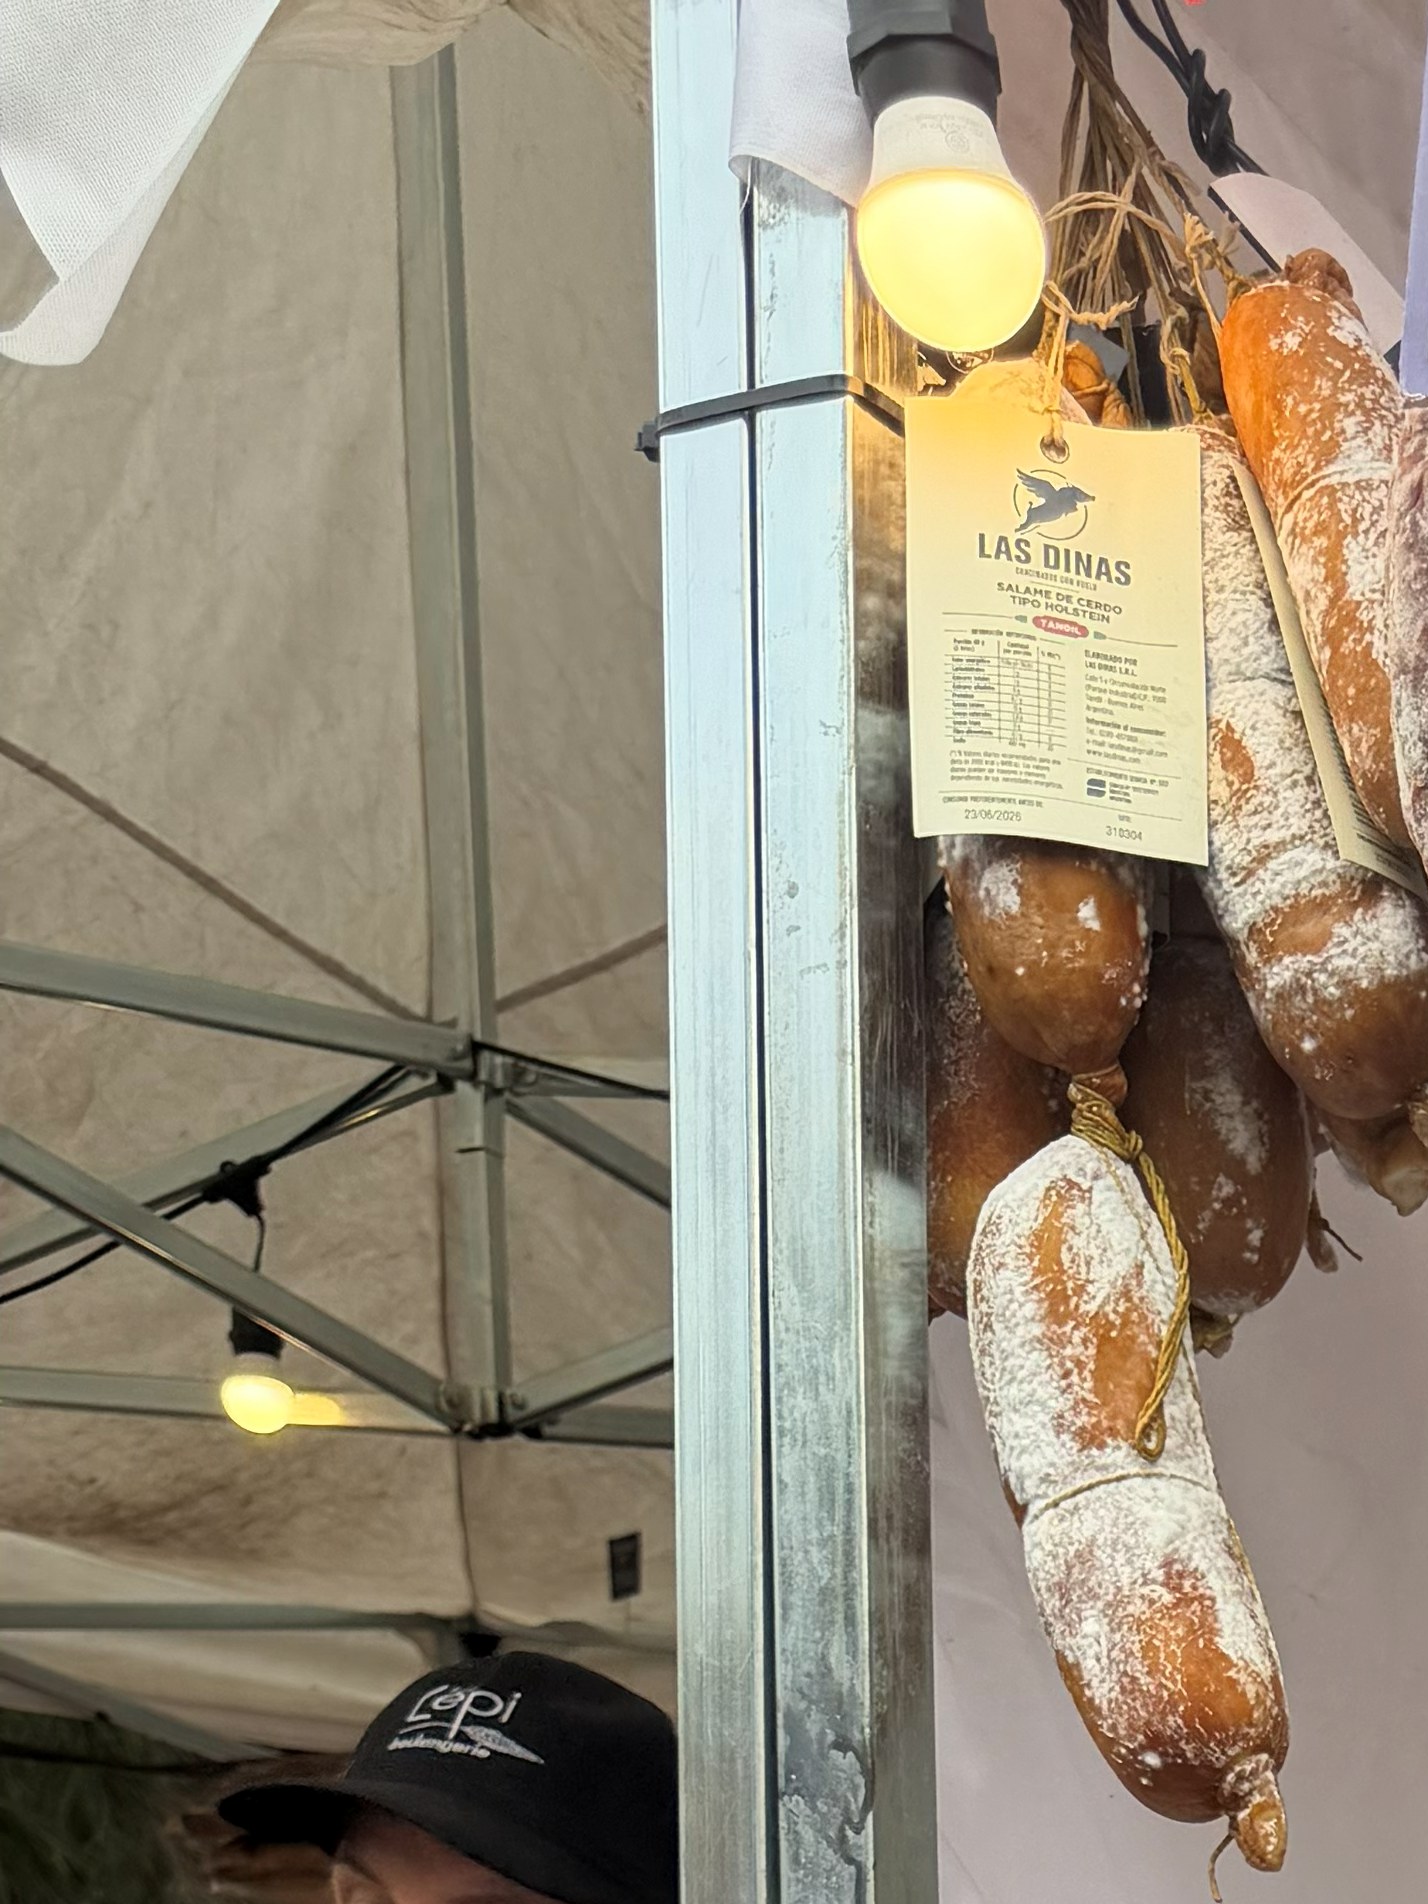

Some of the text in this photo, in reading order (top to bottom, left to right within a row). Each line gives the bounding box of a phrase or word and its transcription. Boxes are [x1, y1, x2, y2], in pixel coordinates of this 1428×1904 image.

[978, 533, 1131, 586] LAS DINAS
[997, 582, 1122, 615] SALAME DE CERDO
[1010, 595, 1110, 623] TIPO HOLSTEIN
